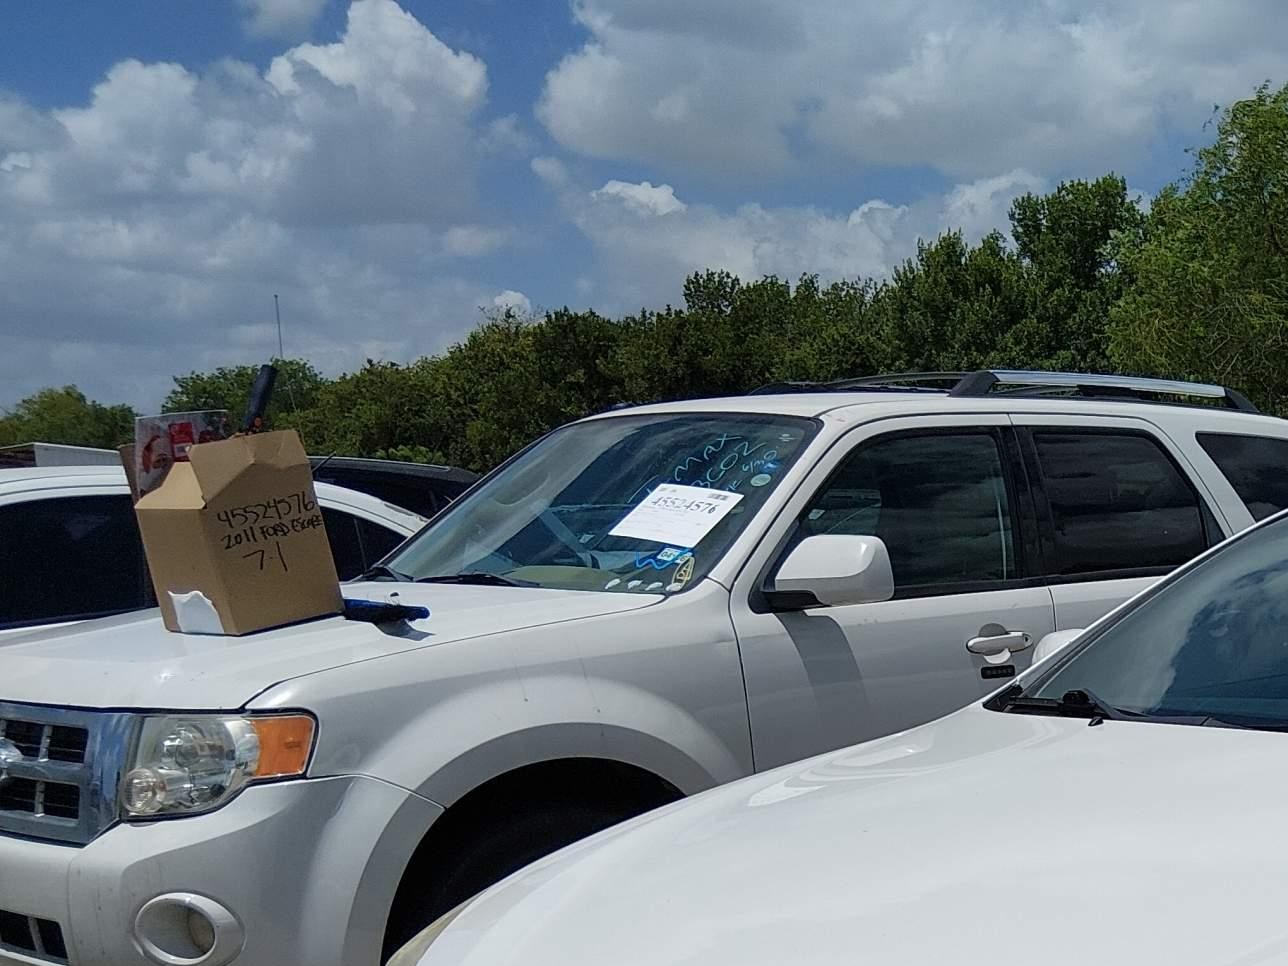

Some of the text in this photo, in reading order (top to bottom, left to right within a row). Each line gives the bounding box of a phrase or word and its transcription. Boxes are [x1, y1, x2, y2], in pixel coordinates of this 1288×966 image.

[217, 491, 315, 529] 45524576
[652, 497, 720, 515] 45524576
[221, 526, 257, 550] 2011
[260, 521, 291, 540] FORD
